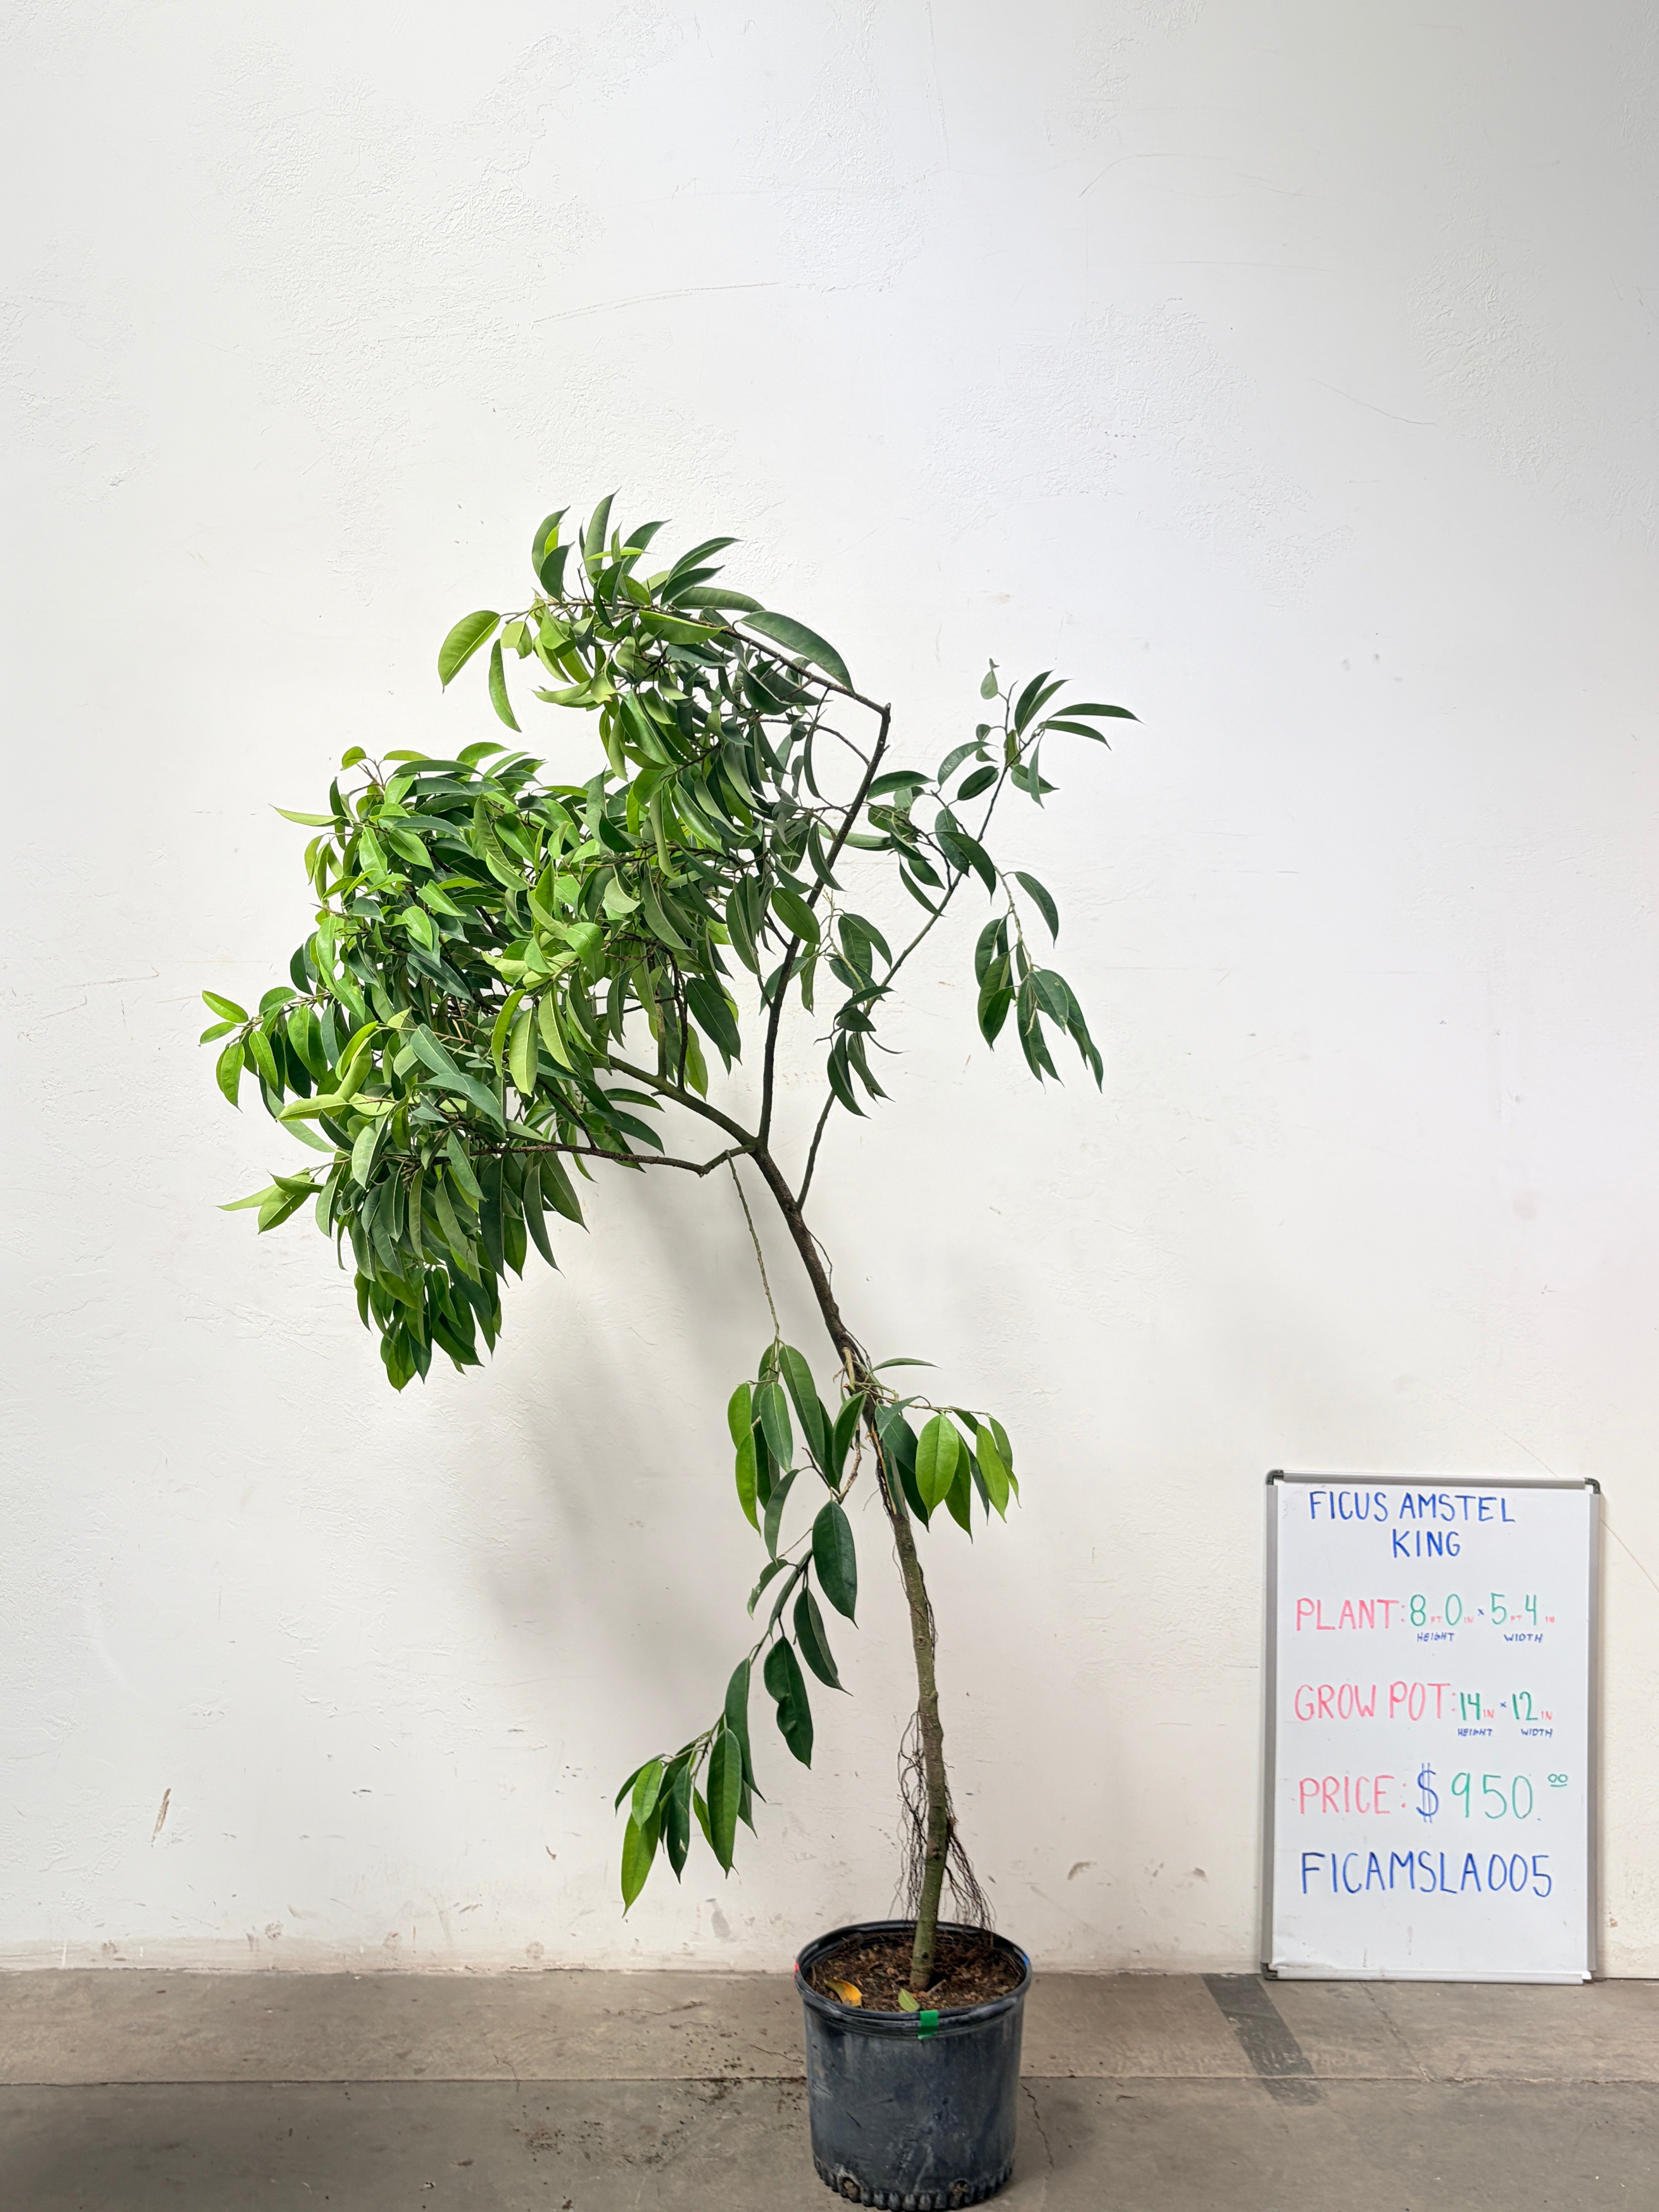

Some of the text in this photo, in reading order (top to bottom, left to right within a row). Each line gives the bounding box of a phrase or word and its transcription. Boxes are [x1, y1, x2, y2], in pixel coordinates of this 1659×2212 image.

[1310, 1491, 1515, 1522] FICUS AMSTEL
[1392, 1529, 1461, 1558] KING
[1296, 1597, 1405, 1632] PLANT:
[1417, 1632, 1455, 1642] HEIGHT
[1504, 1633, 1543, 1643] WIDTH
[1294, 1684, 1376, 1721] GROW
[1389, 1681, 1456, 1721] POT:
[1460, 1692, 1480, 1721] 14
[1512, 1691, 1539, 1721] 12
[1458, 1728, 1493, 1736] HEIGHT
[1520, 1728, 1553, 1738] WIDTH
[1298, 1774, 1407, 1815] PRICE:
[1301, 1850, 1552, 1898] FICAMSLA005
